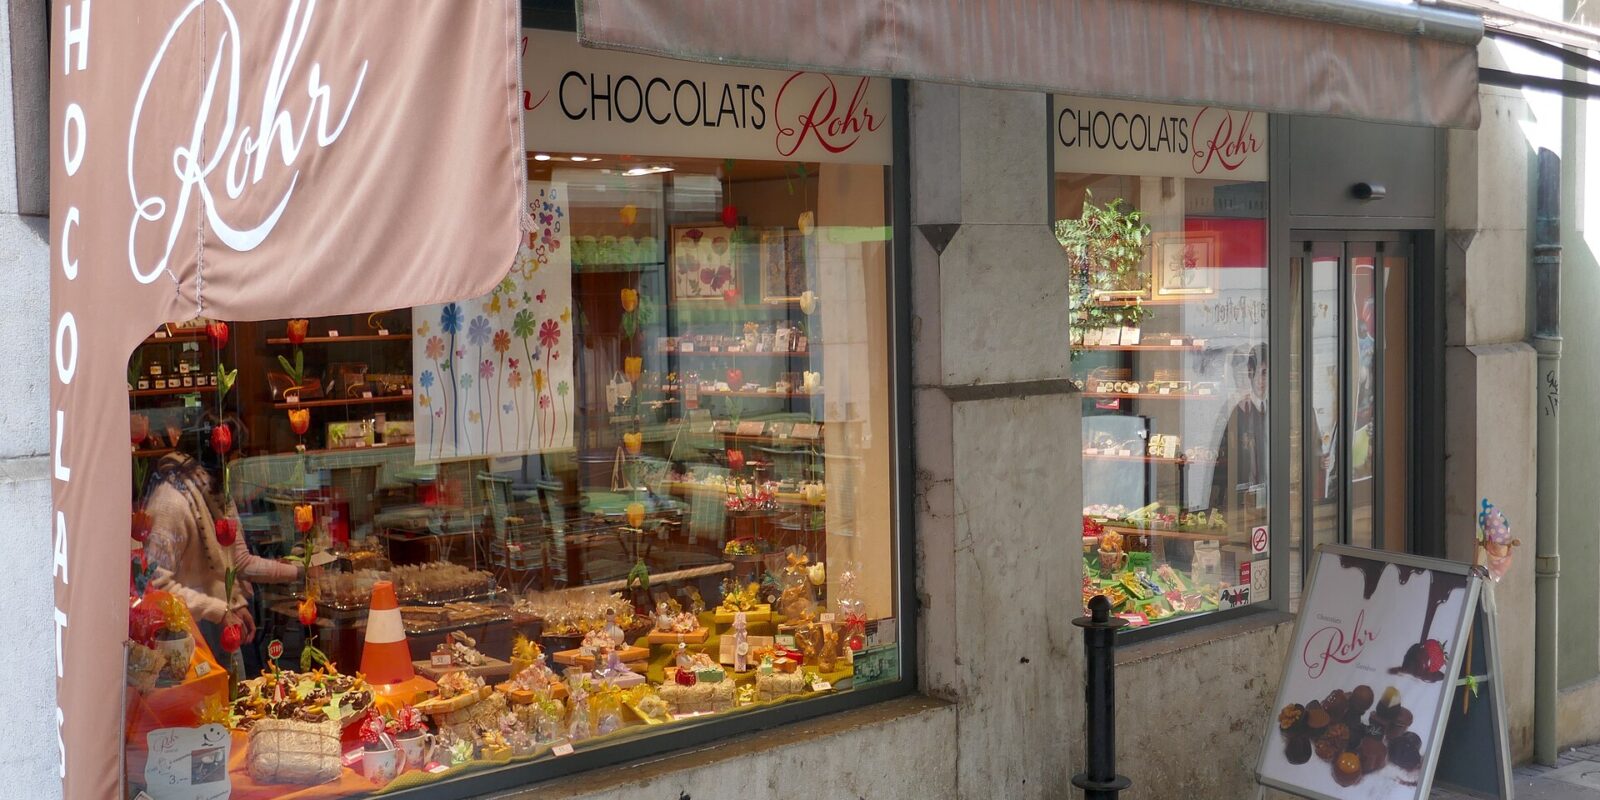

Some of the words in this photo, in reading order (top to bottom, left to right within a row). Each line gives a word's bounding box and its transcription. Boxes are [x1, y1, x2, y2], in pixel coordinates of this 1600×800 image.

[127, 0, 369, 284] Rohr
[558, 70, 766, 130] CHOCOLATS
[774, 71, 887, 157] Rohr
[1057, 107, 1189, 155] CHOCOLATS
[1191, 106, 1263, 174] Rohr
[1303, 608, 1382, 679] Rohr
